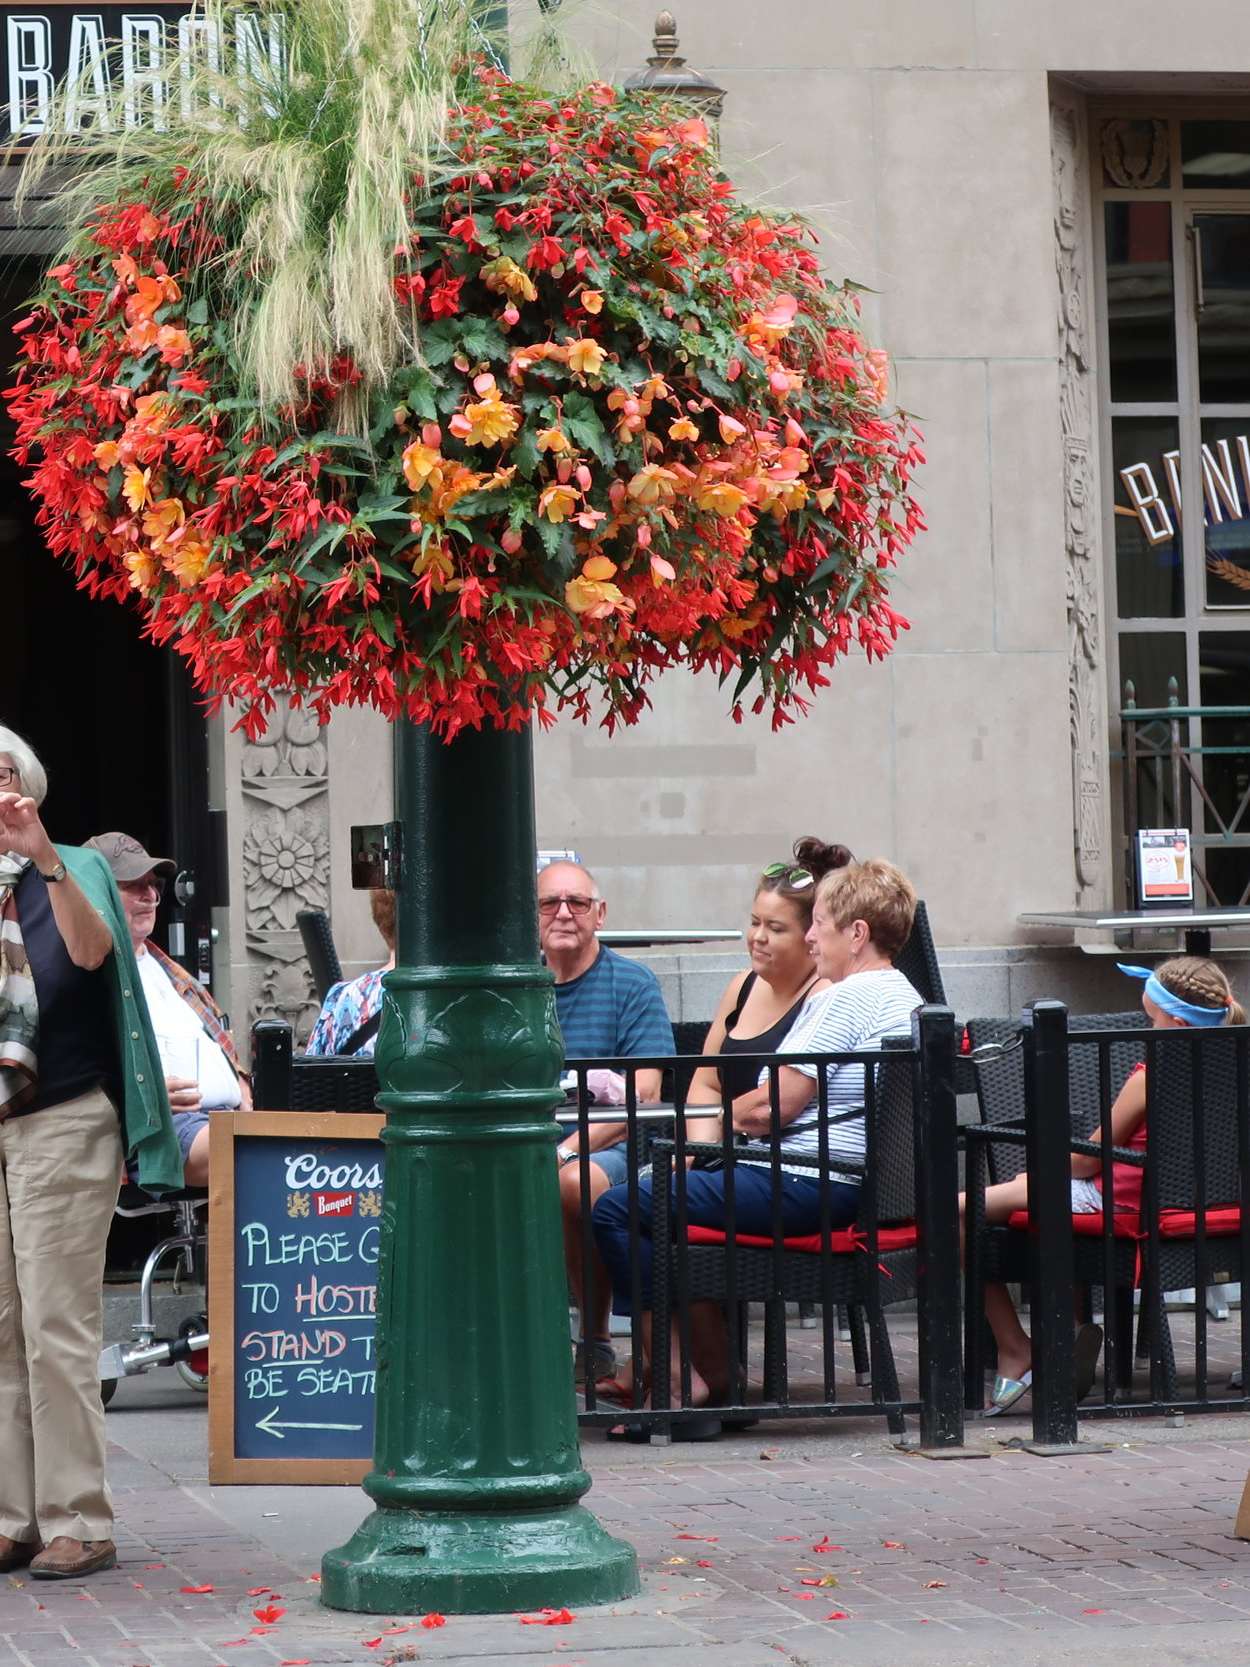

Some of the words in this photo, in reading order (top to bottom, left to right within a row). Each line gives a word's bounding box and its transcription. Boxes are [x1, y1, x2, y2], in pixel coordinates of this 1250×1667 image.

[284, 1153, 383, 1189] Coors
[318, 1195, 353, 1215] Banquet
[241, 1222, 353, 1267] PLEASE
[241, 1283, 280, 1314] TO
[241, 1329, 347, 1361] STAND
[351, 1335, 376, 1361] T
[244, 1368, 289, 1399] BE
